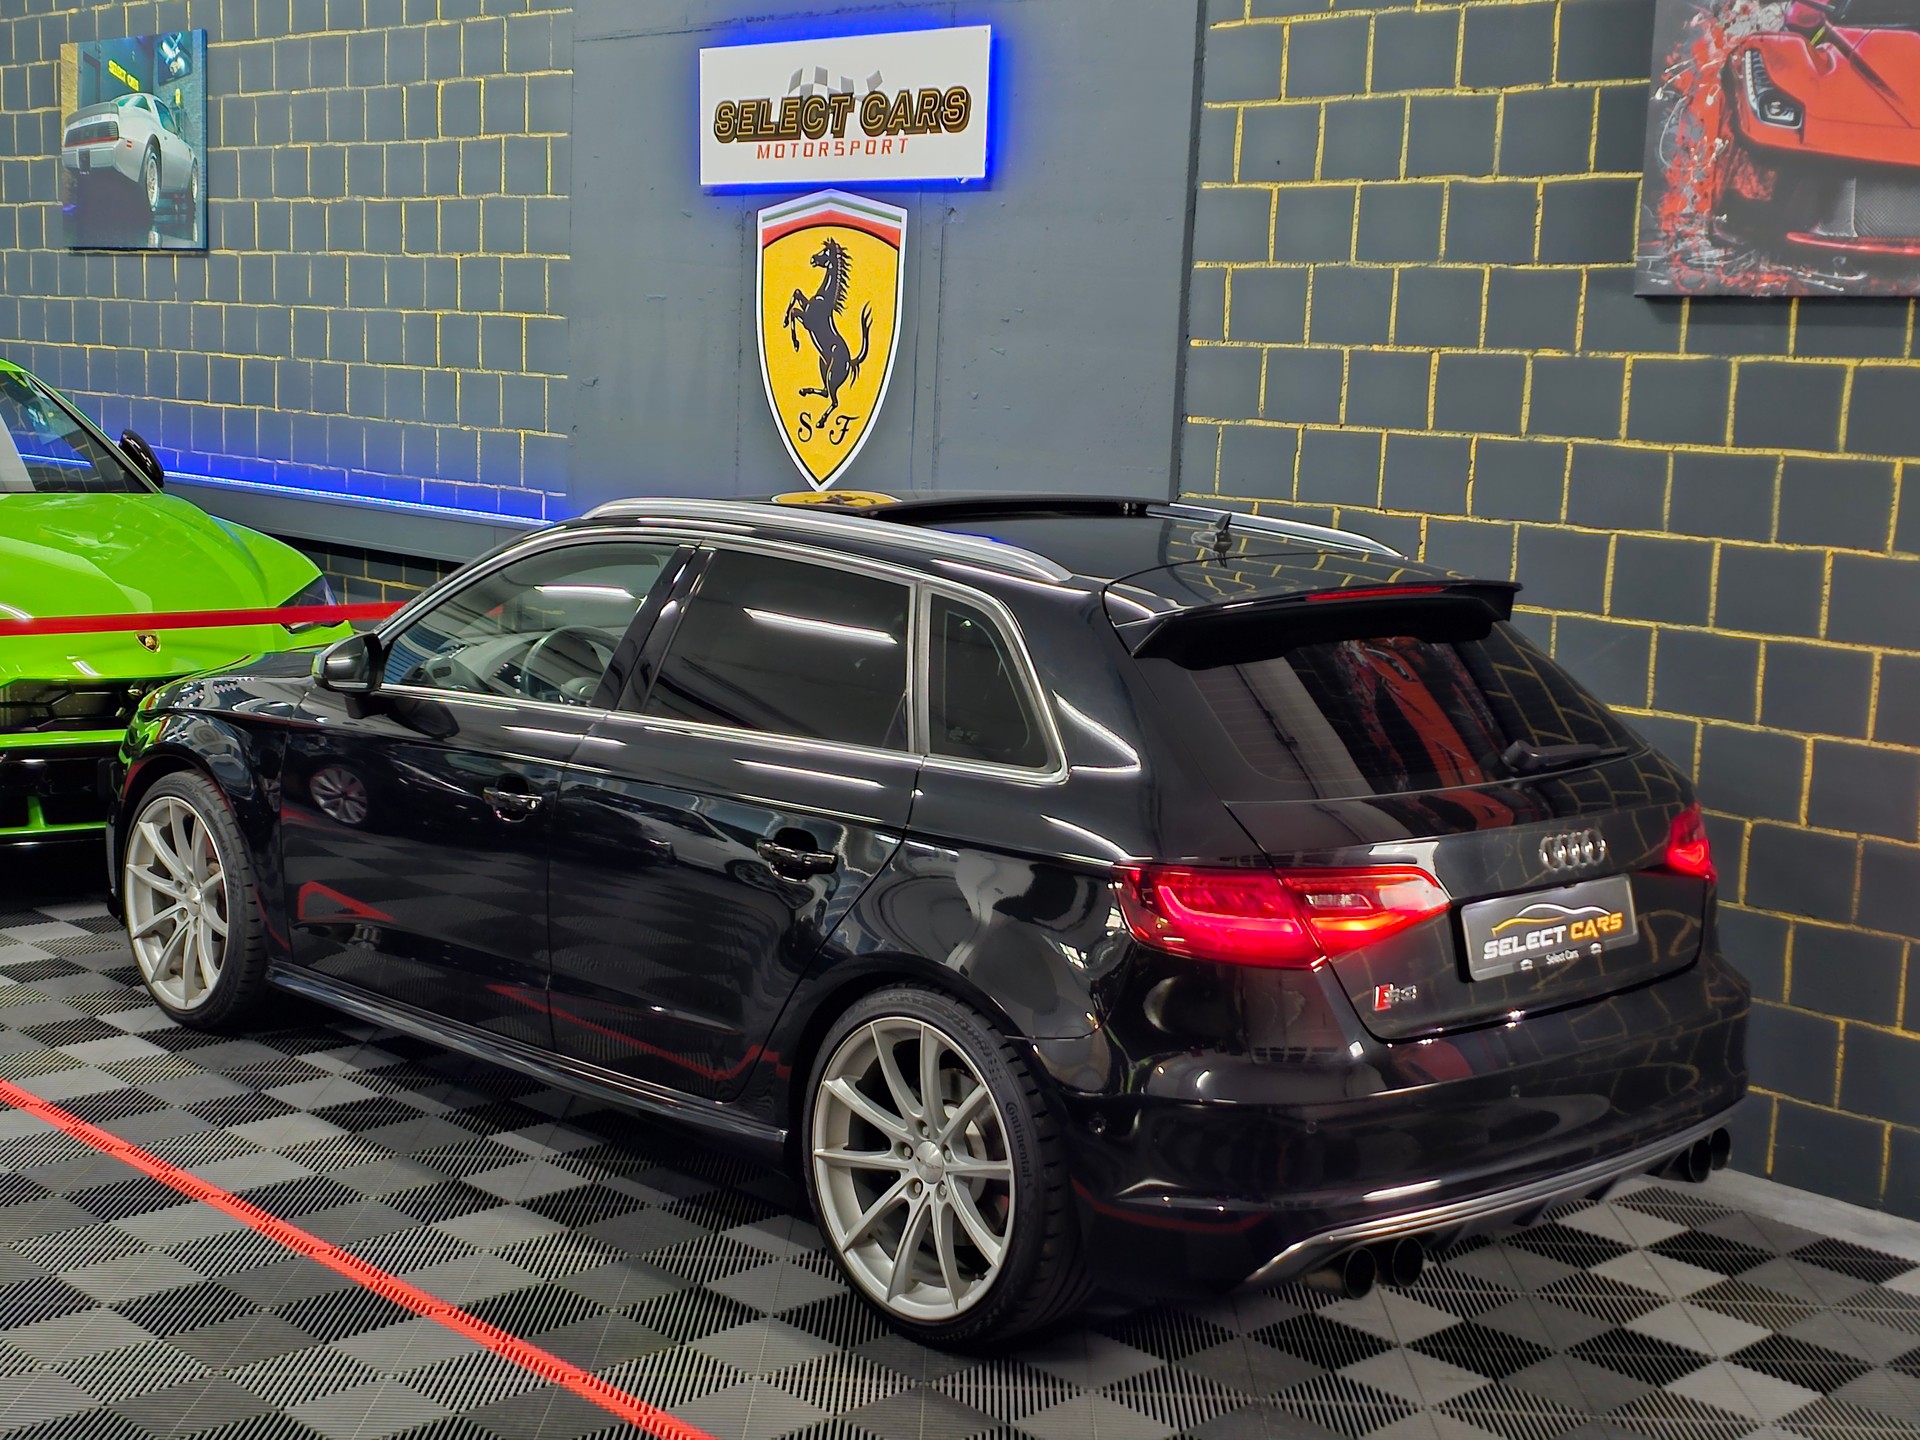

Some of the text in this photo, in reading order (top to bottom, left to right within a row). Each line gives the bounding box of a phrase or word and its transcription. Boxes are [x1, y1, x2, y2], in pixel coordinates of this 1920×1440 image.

[713, 86, 972, 143] SELECT CARS
[757, 138, 909, 160] MOTORSPORT
[797, 412, 813, 442] S
[1483, 912, 1623, 960] SELECT CARS
[1545, 949, 1580, 965] Select Cars
[1005, 1101, 1033, 1178] Continental
